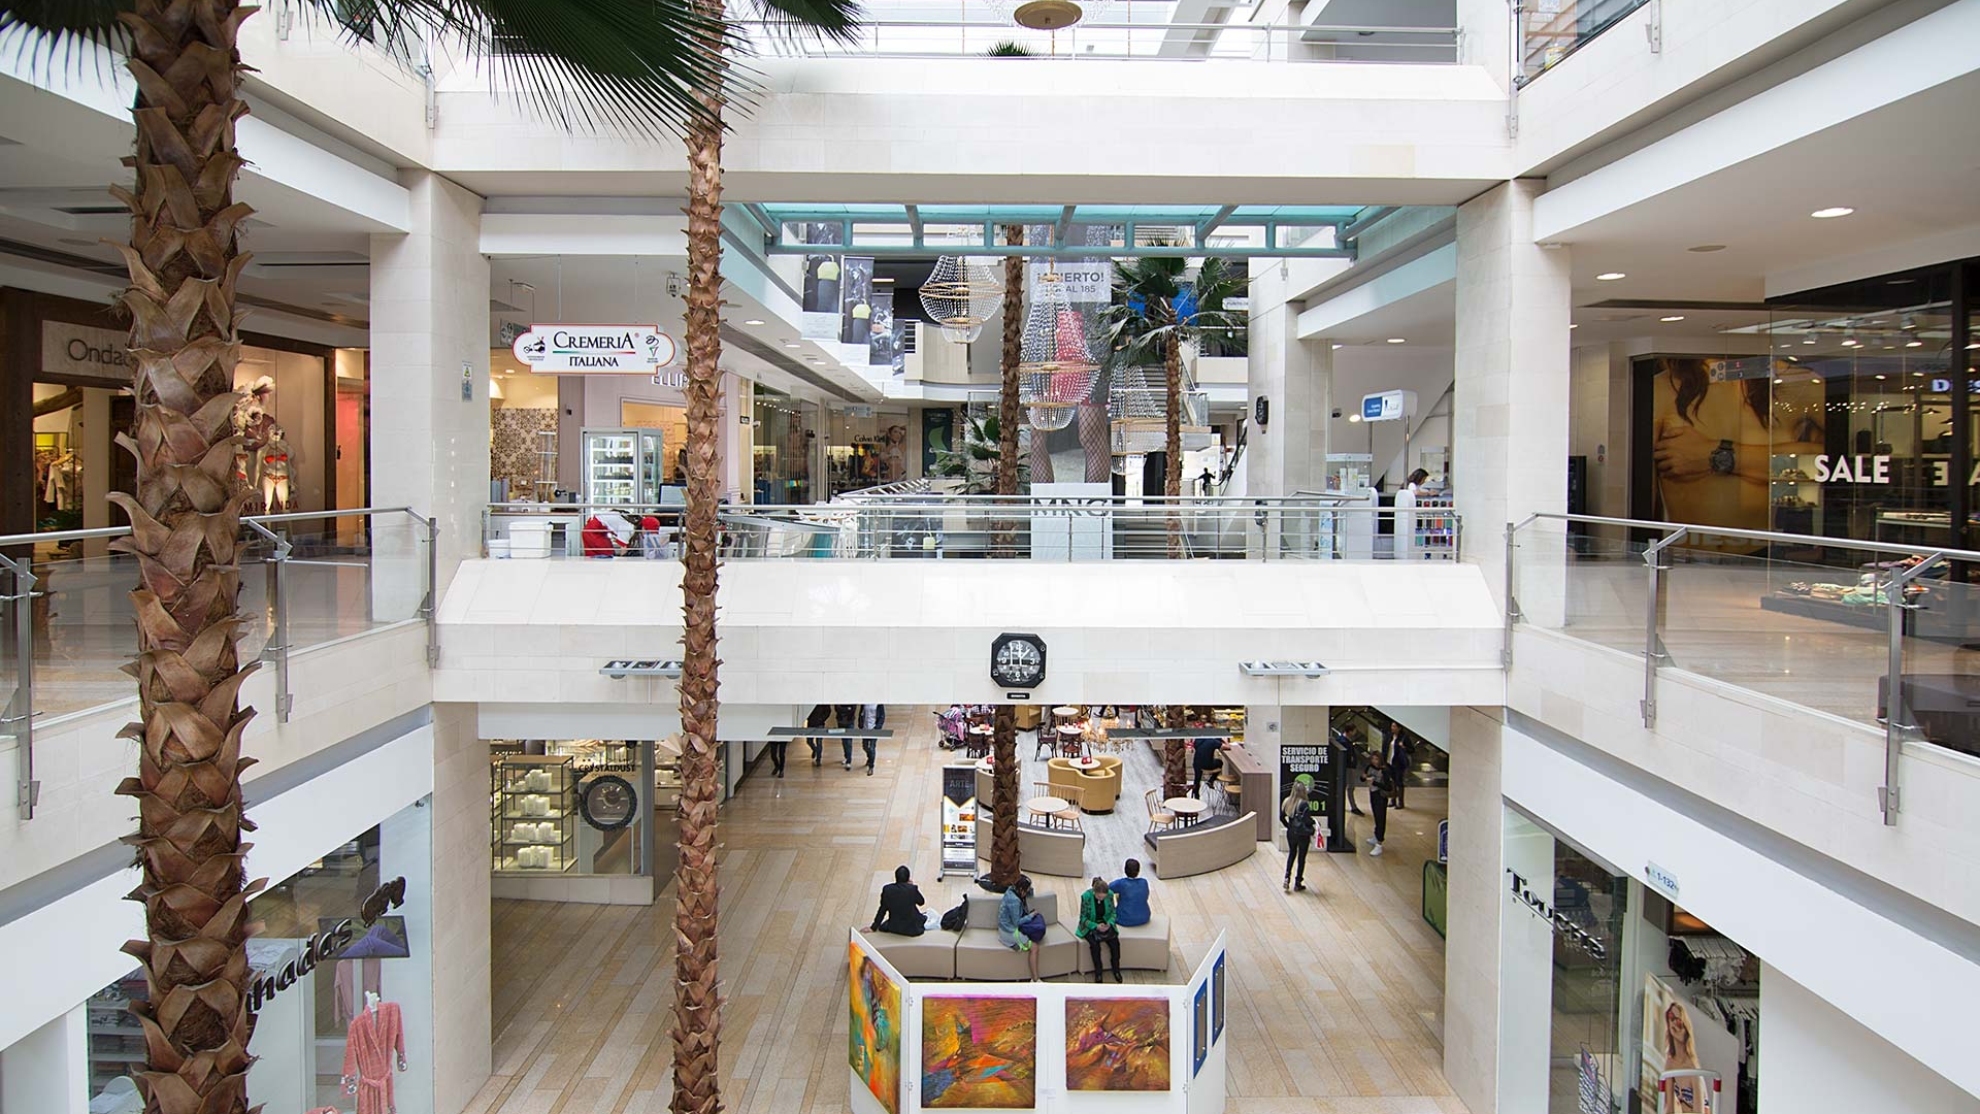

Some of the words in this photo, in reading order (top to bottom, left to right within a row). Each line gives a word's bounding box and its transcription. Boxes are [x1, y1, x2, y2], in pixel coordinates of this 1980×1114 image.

[1081, 285, 1096, 293] 185
[569, 356, 619, 367] ITALIANA
[1814, 454, 1890, 484] SALE
[1282, 746, 1317, 755] SERVICIO
[1318, 746, 1328, 755] DE
[1281, 755, 1329, 764] TRANSPORTE
[1289, 764, 1320, 772] SEGURO
